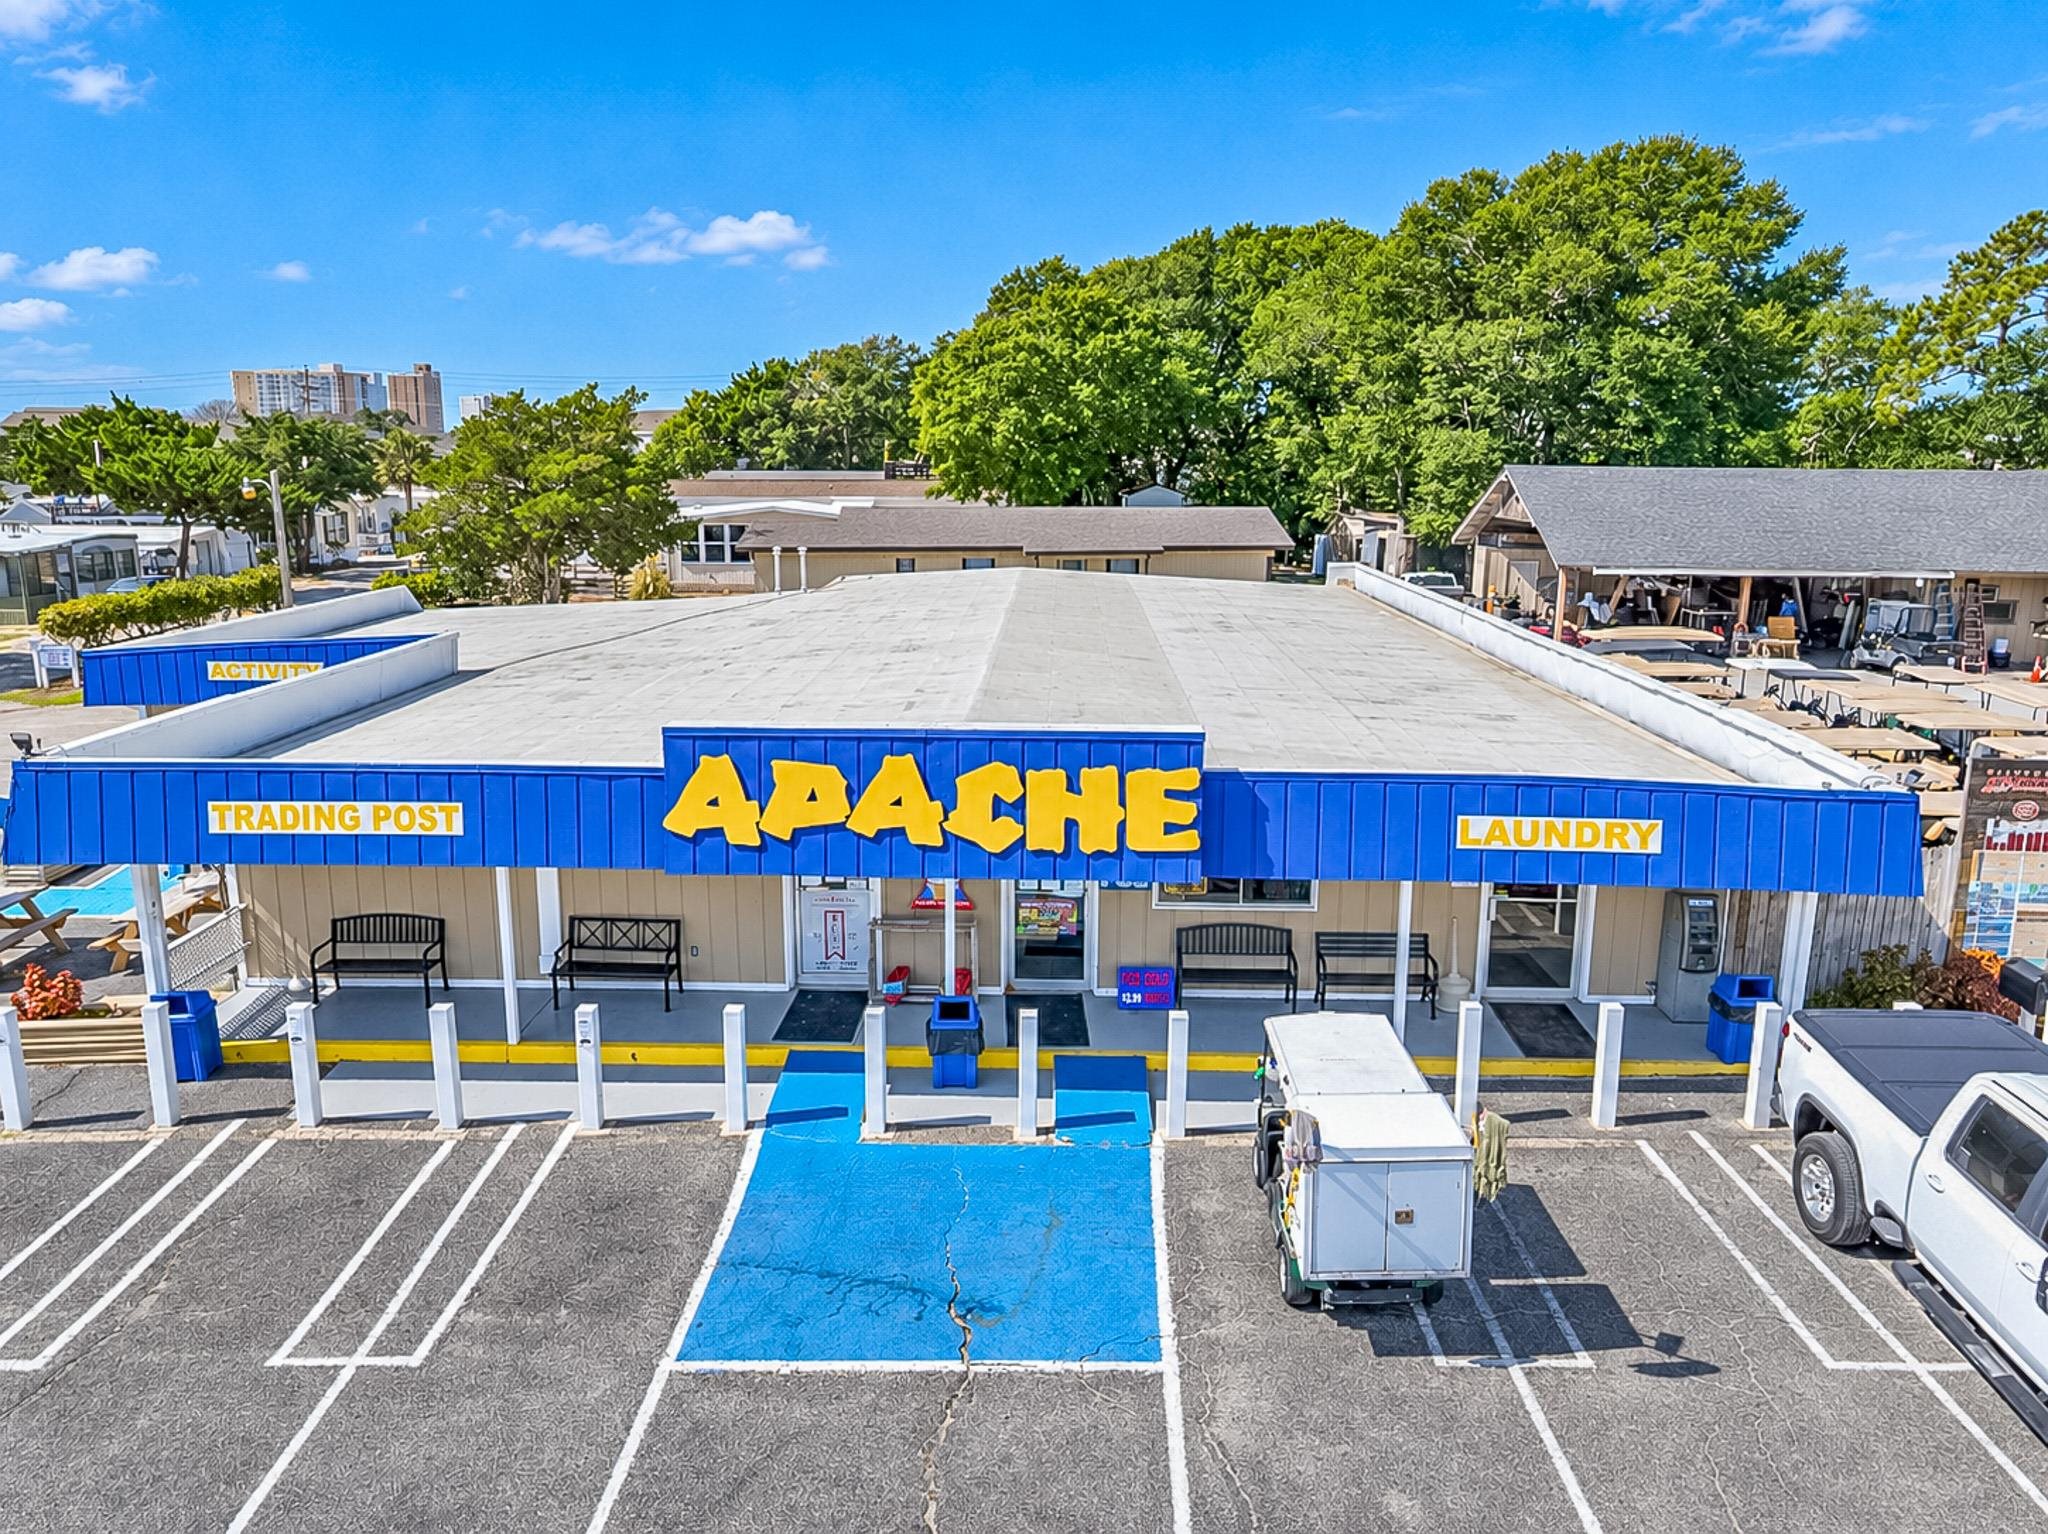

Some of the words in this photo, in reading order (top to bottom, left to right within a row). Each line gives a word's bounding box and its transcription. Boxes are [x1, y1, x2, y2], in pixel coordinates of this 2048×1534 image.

[210, 662, 320, 679] ACTIVITY
[212, 804, 360, 832] TRADING
[372, 805, 459, 833] POST
[662, 754, 1201, 854] APACHE
[1459, 818, 1660, 850] LAUNDRY
